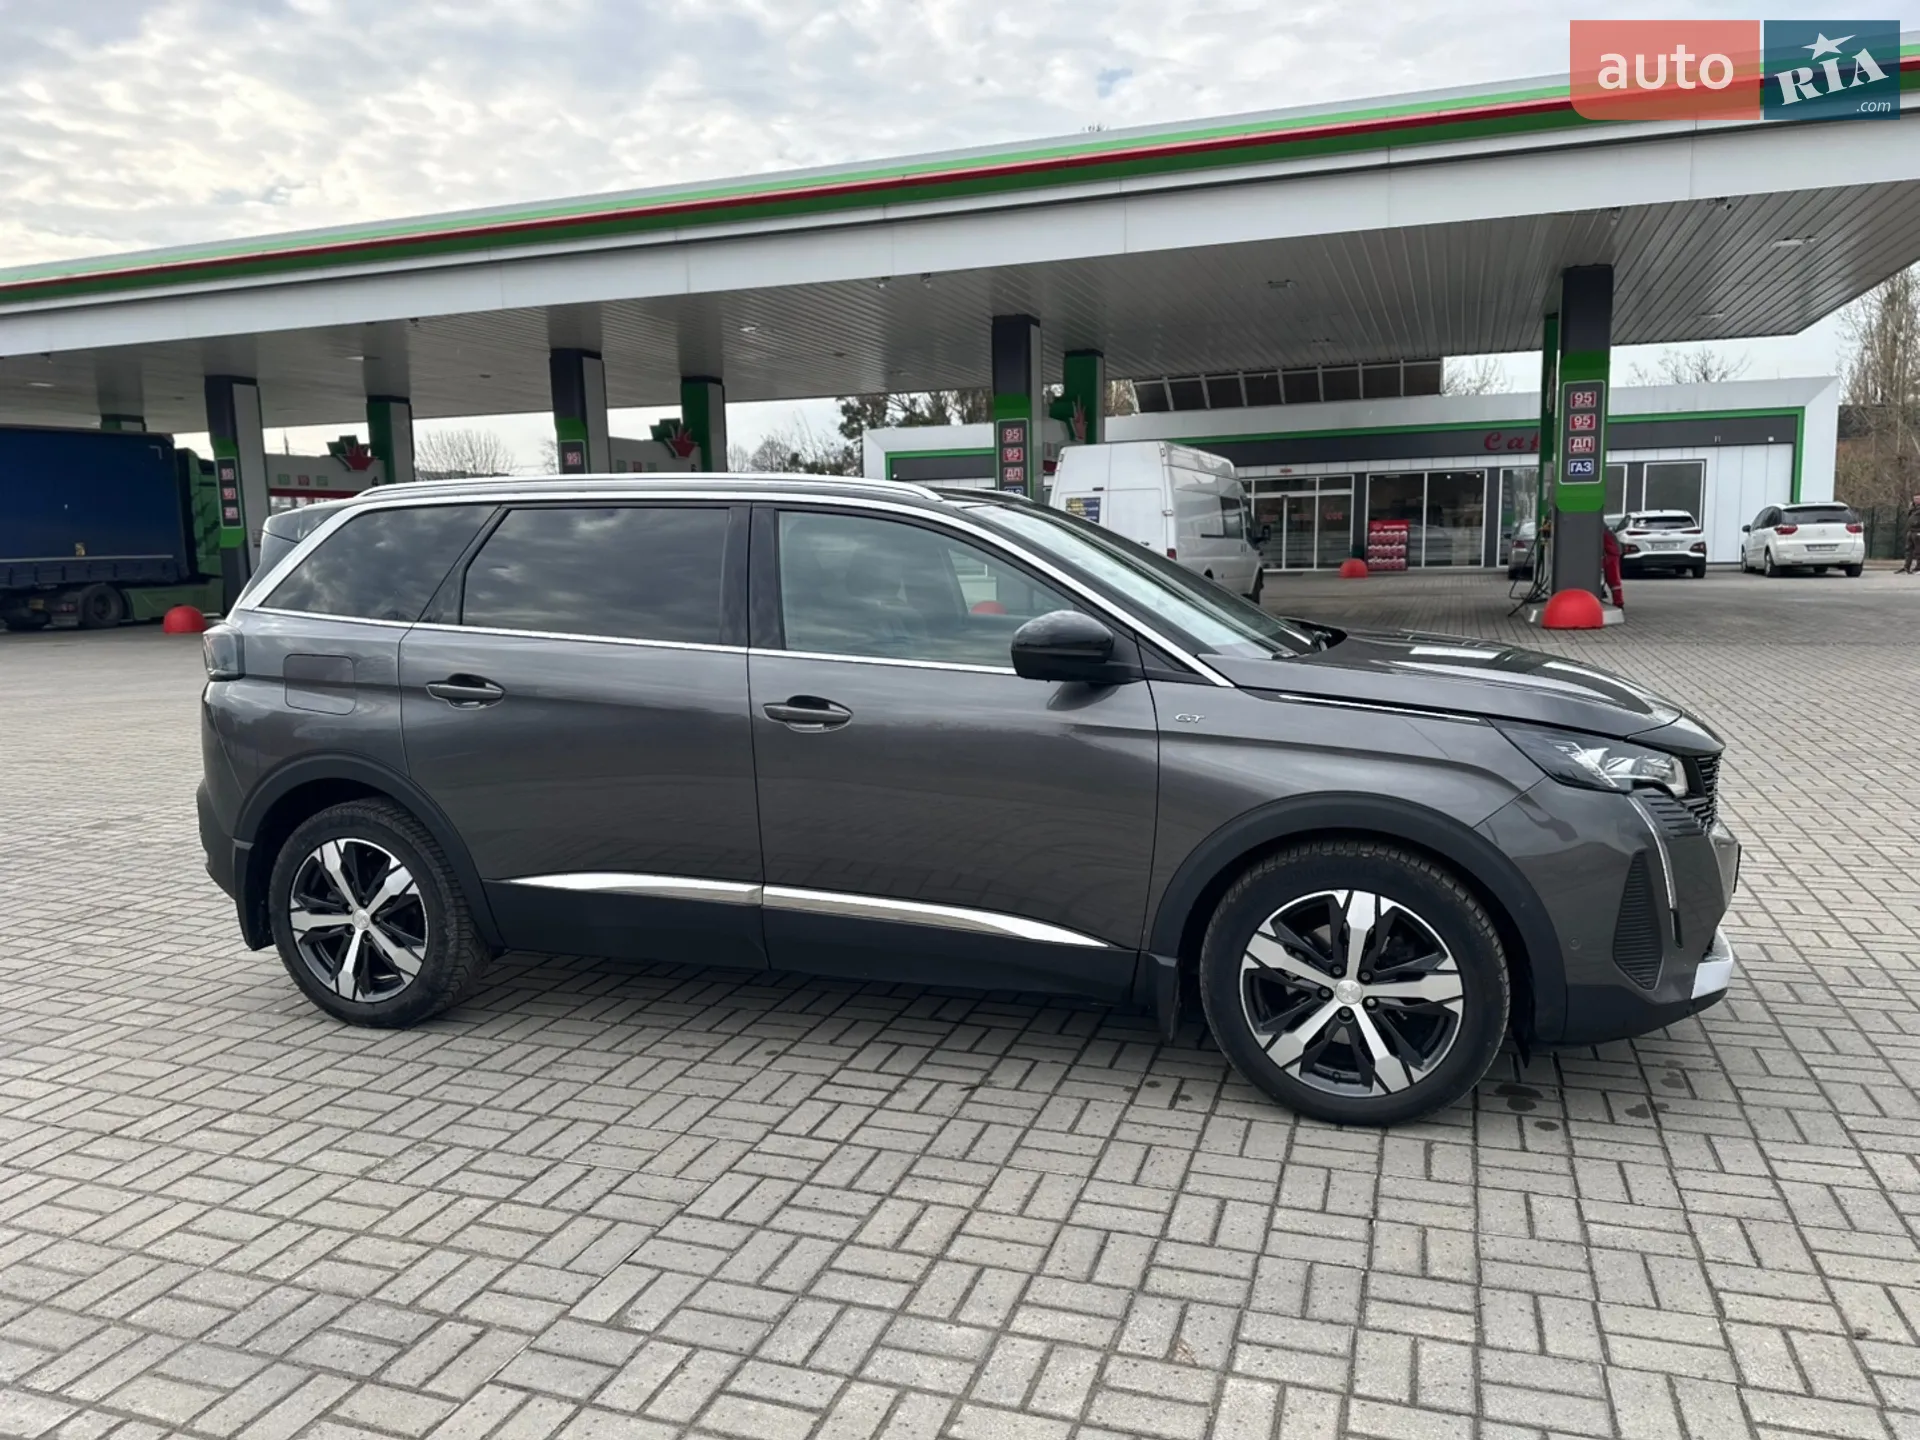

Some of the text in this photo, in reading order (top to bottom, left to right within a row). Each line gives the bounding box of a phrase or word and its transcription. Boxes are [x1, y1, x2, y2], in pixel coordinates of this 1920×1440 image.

[1574, 392, 1592, 404] 95
[1574, 416, 1591, 426] 95
[1006, 429, 1019, 438] 95
[1572, 439, 1591, 449] ДП
[1006, 449, 1019, 458] 95
[1570, 462, 1592, 473] ГАЗ
[1175, 713, 1205, 723] GT
